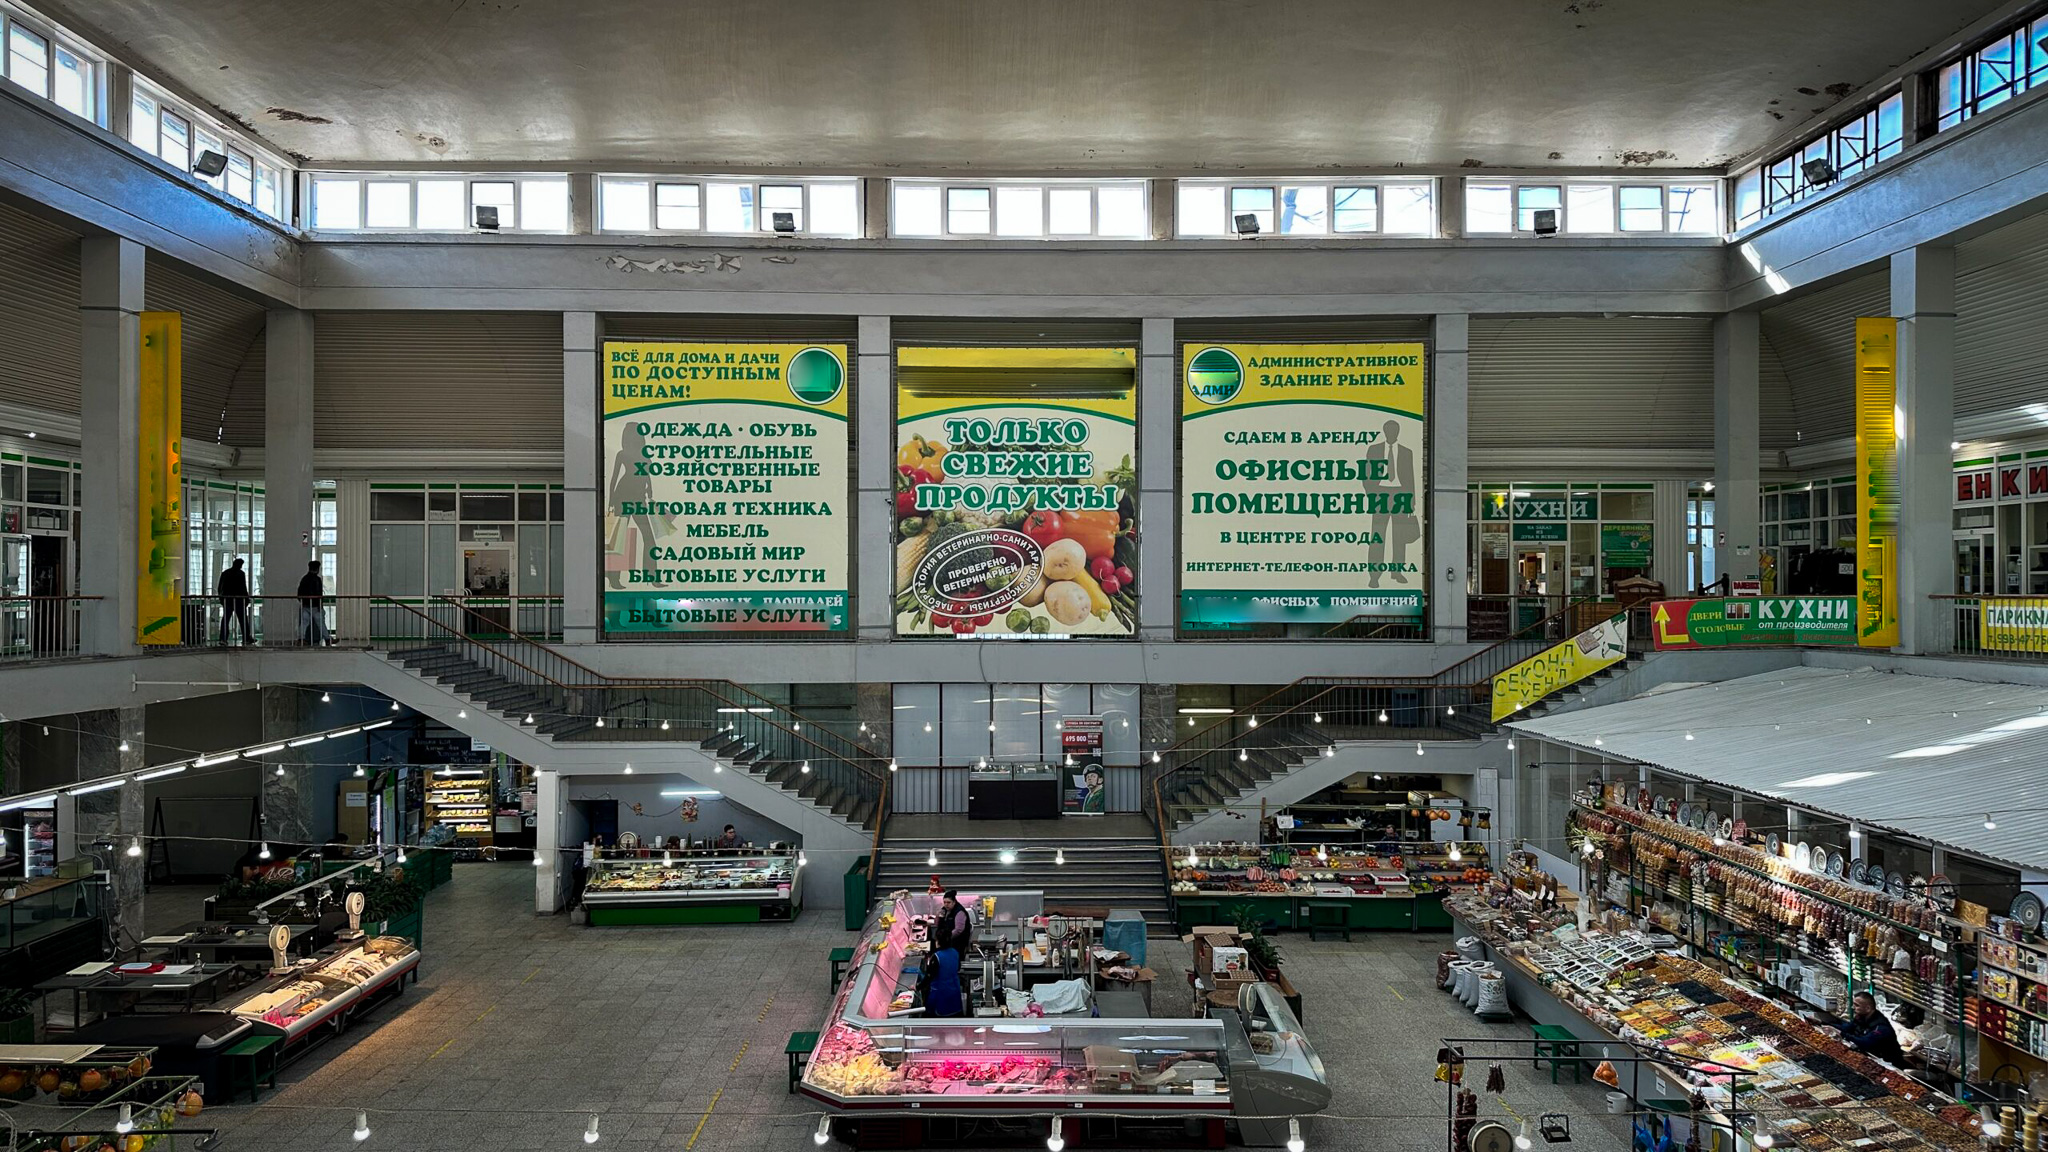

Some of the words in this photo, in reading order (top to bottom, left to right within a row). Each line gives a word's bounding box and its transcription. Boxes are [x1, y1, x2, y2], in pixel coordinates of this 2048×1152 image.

[611, 349, 640, 363] ВСЁ
[643, 352, 674, 364] ДЛЯ
[678, 353, 720, 364] ДОМА
[725, 353, 736, 364] И
[739, 354, 780, 365] ДАЧИ
[1248, 356, 1418, 368] АДМИНИСТРАТИВНОЕ
[611, 366, 640, 378] ПО
[646, 366, 780, 381] ДОСТУПНЫМ
[1260, 374, 1332, 388] ЗДАНИЕ
[1338, 374, 1405, 386] РЫНКА
[612, 384, 691, 400] ЦЕНАМ!
[636, 422, 732, 438] ОДЕЖДА
[750, 424, 818, 438] ОБУВЬ
[945, 420, 1088, 445] ТОЛЬКО
[1224, 431, 1286, 445] СДАЕМ
[1291, 432, 1302, 444] В
[1307, 431, 1380, 446] АРЕНДУ
[641, 445, 813, 460] СТРОИТЕЛЬНЫЕ
[634, 460, 820, 476] ХОЗЯЙСТВЕННЫЕ
[942, 452, 1093, 478] СВЕЖИЕ
[1216, 459, 1390, 480] ОФИСНЫЕ
[682, 480, 772, 493] ТОВАРЫ
[916, 485, 1119, 514] ПРОДУКТЫ
[1191, 492, 1414, 518] ПОМЕЩЕНИЯ
[622, 502, 726, 516] БЫТОВАЯ
[732, 502, 832, 516] ТЕХНИКА
[1490, 501, 1588, 518] КУХНИ
[686, 524, 769, 538] МЕБЕЛЬ
[1220, 532, 1231, 544] В
[1236, 532, 1306, 545] ЦЕНТРЕ
[1311, 532, 1384, 545] ГОРОДА
[649, 543, 756, 562] САДОВЫЙ
[762, 546, 806, 560] МИР
[947, 556, 1007, 580] ПРОВЕРЕНО
[1186, 562, 1418, 573] ИНТЕРНЕТ-ТЕЛЕФОН-ПАРКОВКА
[628, 569, 737, 583] БЫТОВЫЕ
[743, 569, 826, 583] УСЛУГИ
[942, 562, 1018, 592] ВЕТЕРИНАРИЕЙ
[918, 558, 954, 612] ЛАБОРАТОРИЯ
[970, 582, 1028, 612] ЭКСПЕРТИЗЫ
[1690, 612, 1722, 622] ДВЕРИ
[1758, 600, 1848, 620] КУХНИ
[1776, 621, 1848, 632] производителя
[1494, 644, 1574, 697] СЕКОНД
[1520, 668, 1567, 704] ХЕНД
